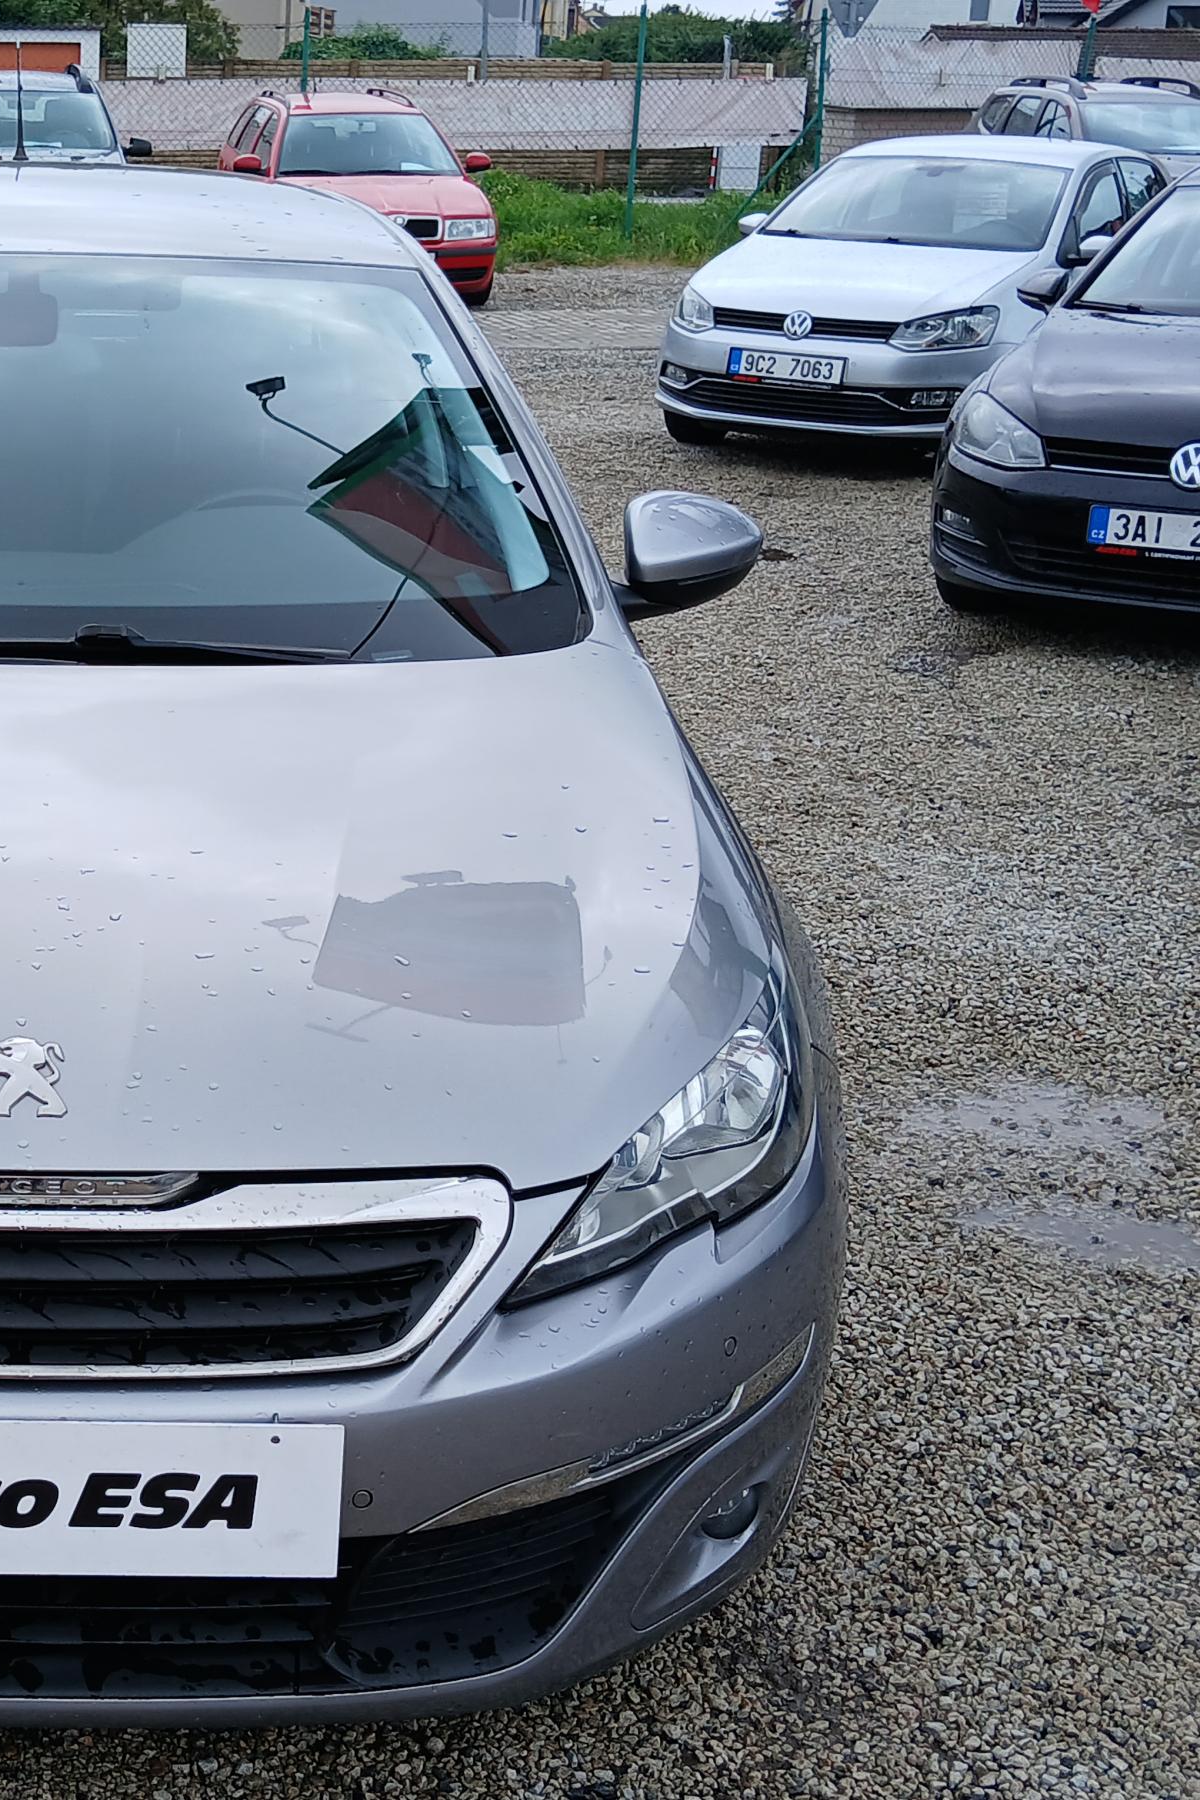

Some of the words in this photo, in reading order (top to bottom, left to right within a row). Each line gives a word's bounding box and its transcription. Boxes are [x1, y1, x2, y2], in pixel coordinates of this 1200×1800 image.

[744, 354, 776, 375] 9C2
[789, 358, 834, 380] 7063
[1091, 529, 1105, 539] CZ
[1113, 513, 1163, 544] 3AI
[67, 1472, 259, 1530] ESA
